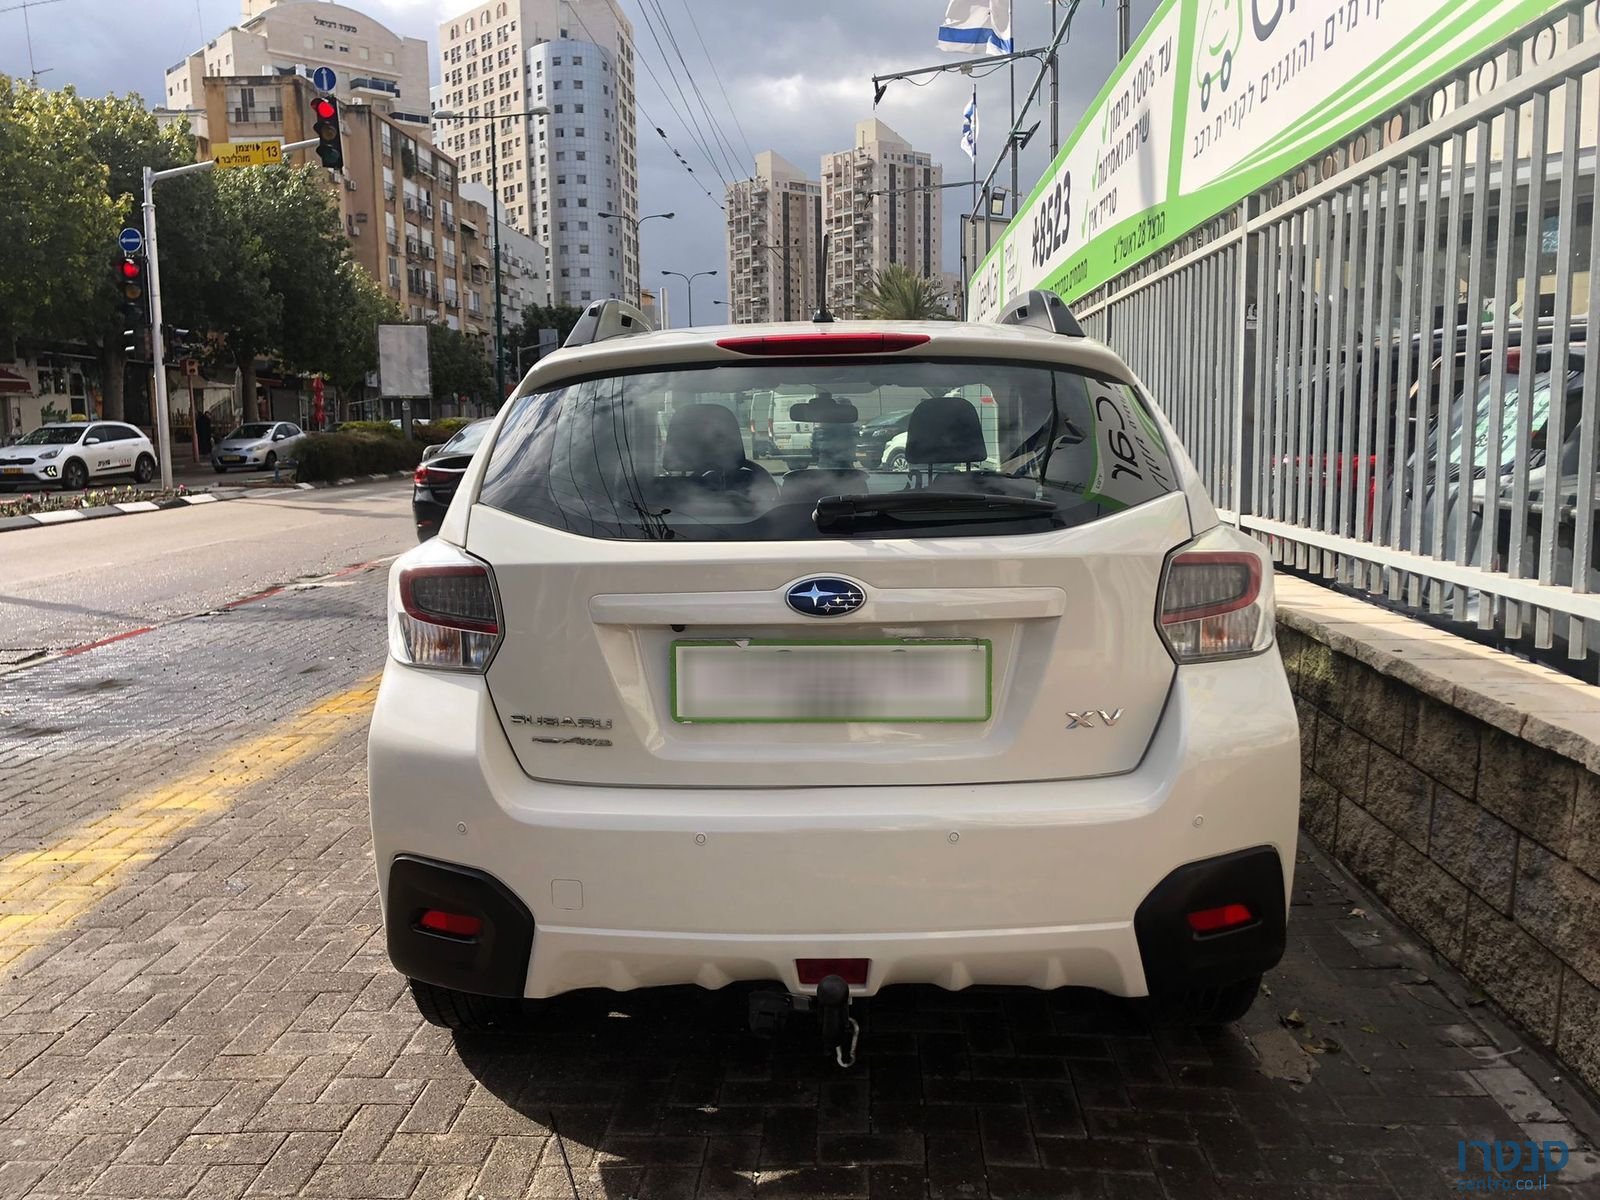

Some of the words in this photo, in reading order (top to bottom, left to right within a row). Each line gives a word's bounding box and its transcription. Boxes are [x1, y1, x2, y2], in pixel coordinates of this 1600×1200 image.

[1158, 36, 1172, 77] עד
[1260, 30, 1315, 104] והוגנים
[1132, 54, 1155, 109] 100%
[1110, 90, 1130, 144] מימון
[1214, 81, 1255, 142] לקניית
[235, 144, 255, 155] ויצמן
[265, 146, 278, 157] 13
[1125, 109, 1150, 161] שירות
[1193, 125, 1210, 159] רכב
[1097, 143, 1124, 189] ואמינות
[1137, 218, 1146, 248] 28
[1147, 211, 1166, 243] הרצל
[510, 715, 613, 730] SUBARU
[1065, 708, 1126, 729] XV
